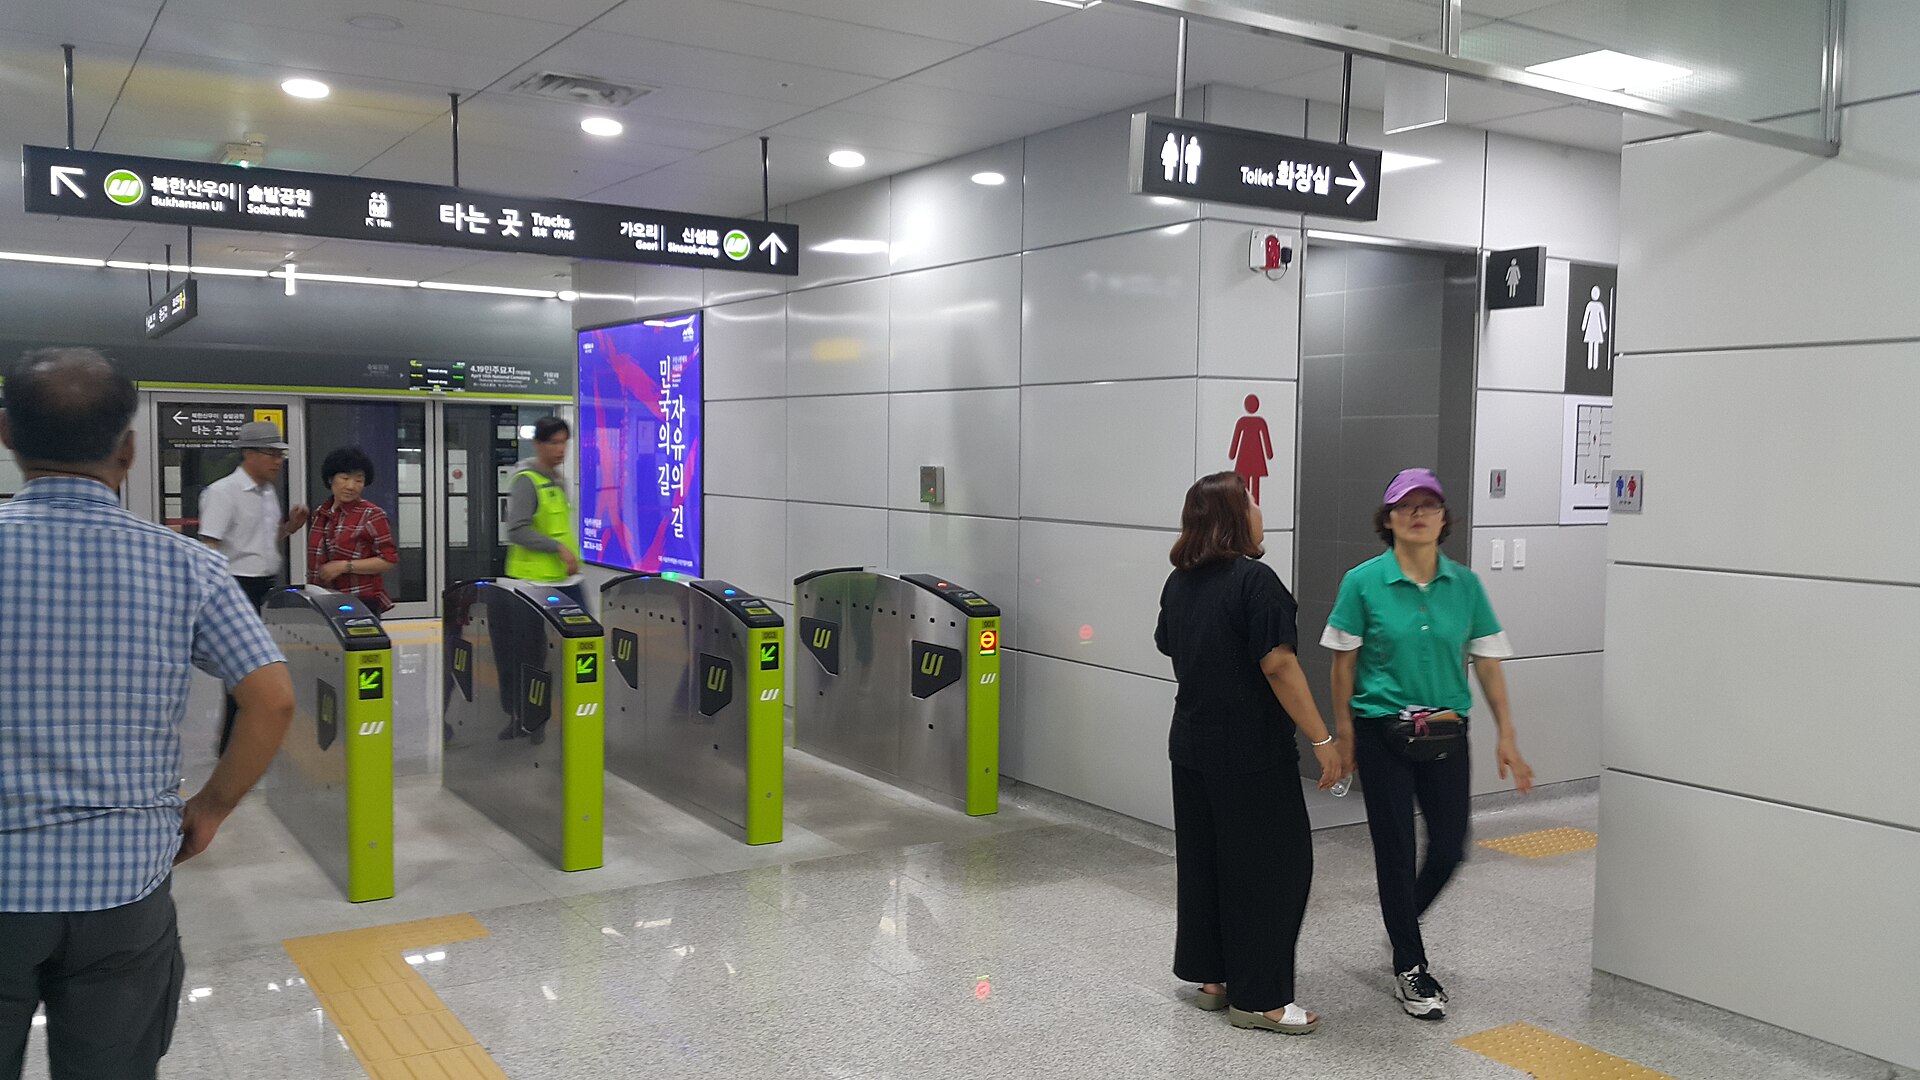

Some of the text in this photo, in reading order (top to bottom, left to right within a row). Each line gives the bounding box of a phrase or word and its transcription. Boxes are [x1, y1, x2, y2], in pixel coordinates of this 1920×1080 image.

[1240, 166, 1273, 188] Toilet
[1275, 160, 1330, 196] 화장실
[151, 176, 311, 207] 북한산우이 솔밭공원
[151, 196, 208, 211] Bukhansan
[247, 204, 305, 218] Solbat Park
[439, 202, 523, 238] 타는 곳
[530, 212, 571, 229] Tracks
[620, 221, 658, 240] 가오리
[682, 227, 719, 246] 신설동
[635, 240, 658, 251] Gaori
[192, 425, 211, 436] 타는
[213, 425, 223, 436] 곳
[658, 355, 672, 497] 민국의 길
[670, 394, 685, 498] 자유의
[671, 505, 684, 539] 길
